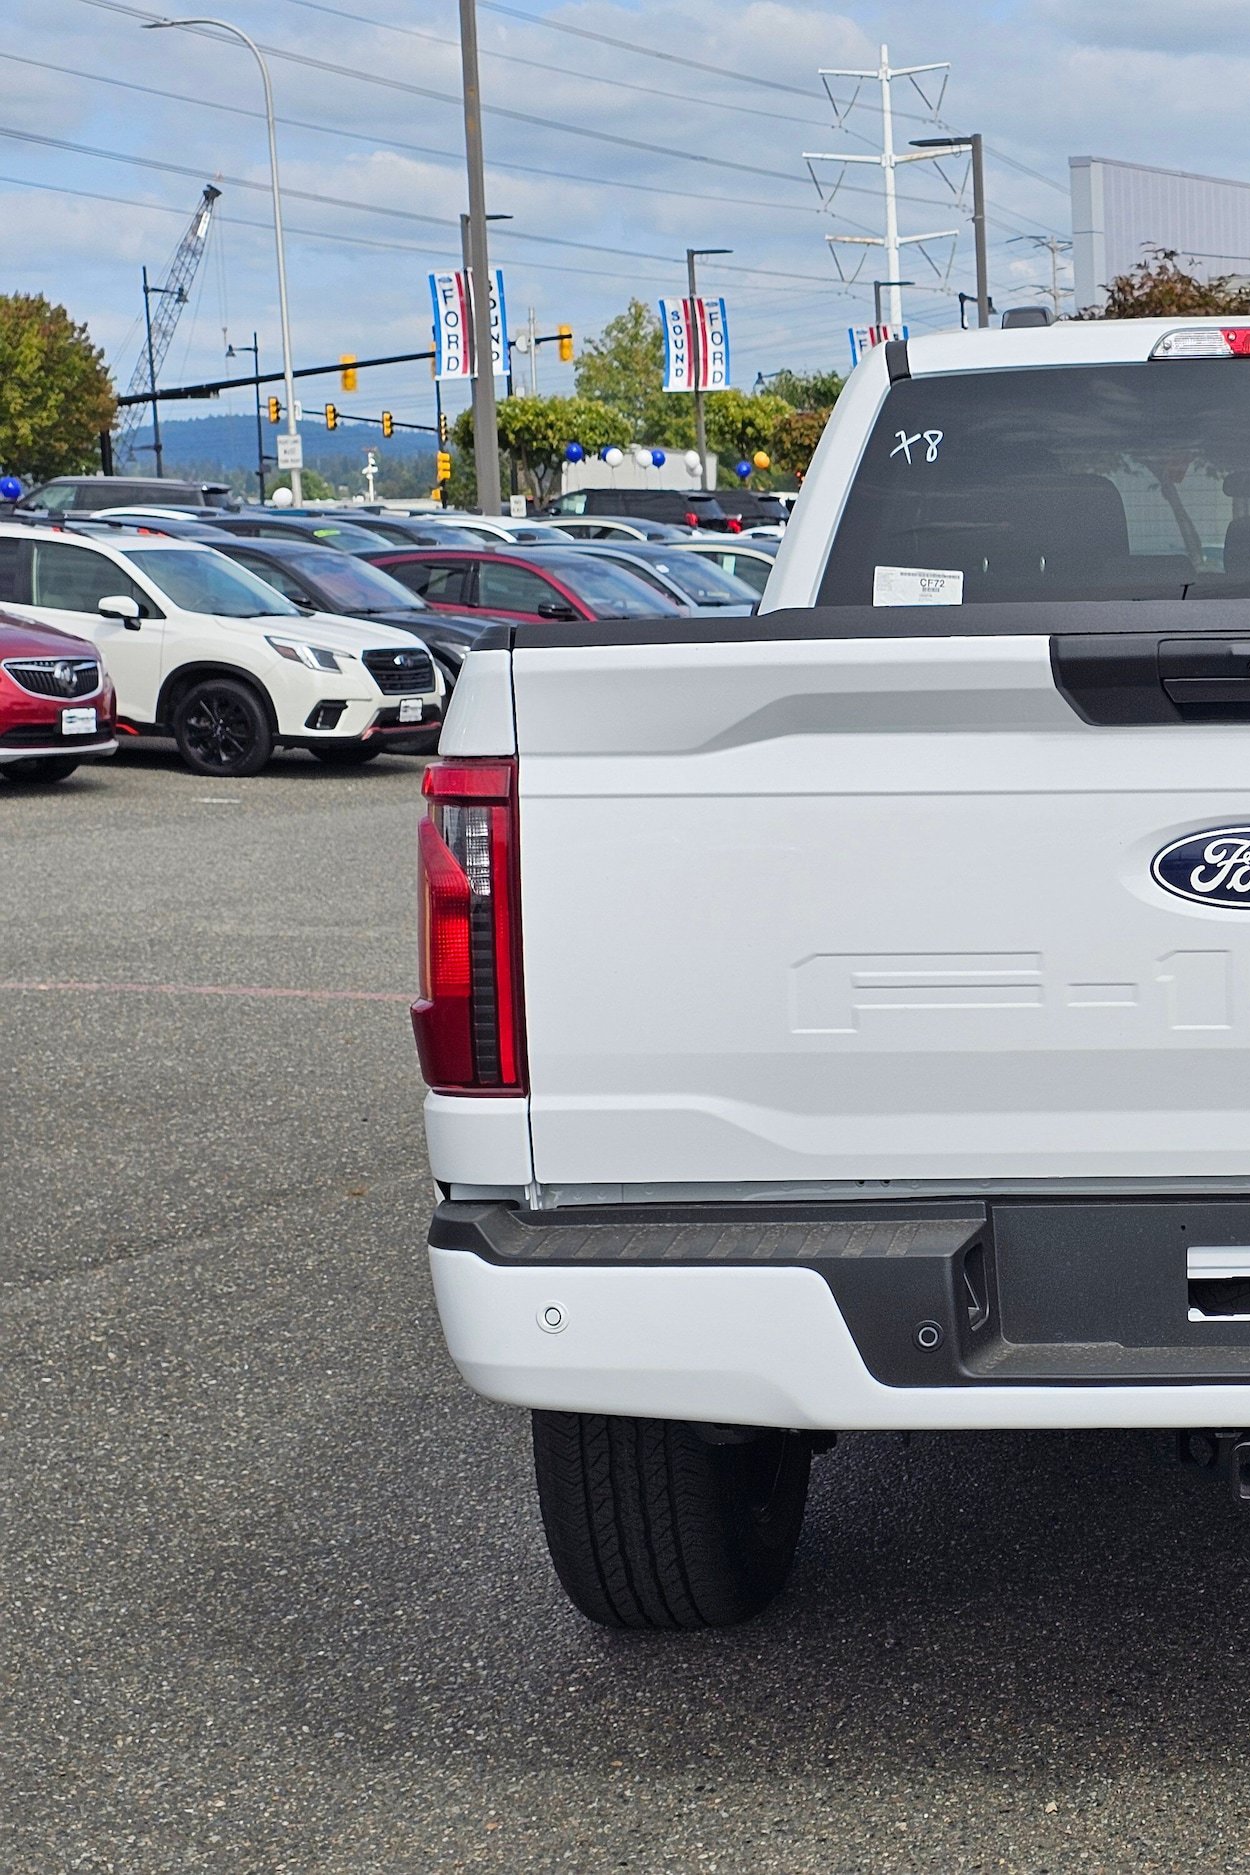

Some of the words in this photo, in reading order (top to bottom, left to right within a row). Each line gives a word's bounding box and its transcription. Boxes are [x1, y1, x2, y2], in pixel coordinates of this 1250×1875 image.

[441, 288, 460, 372] FORD
[670, 310, 684, 378] SOUND
[708, 311, 724, 384] FORD
[919, 578, 945, 588] CF72
